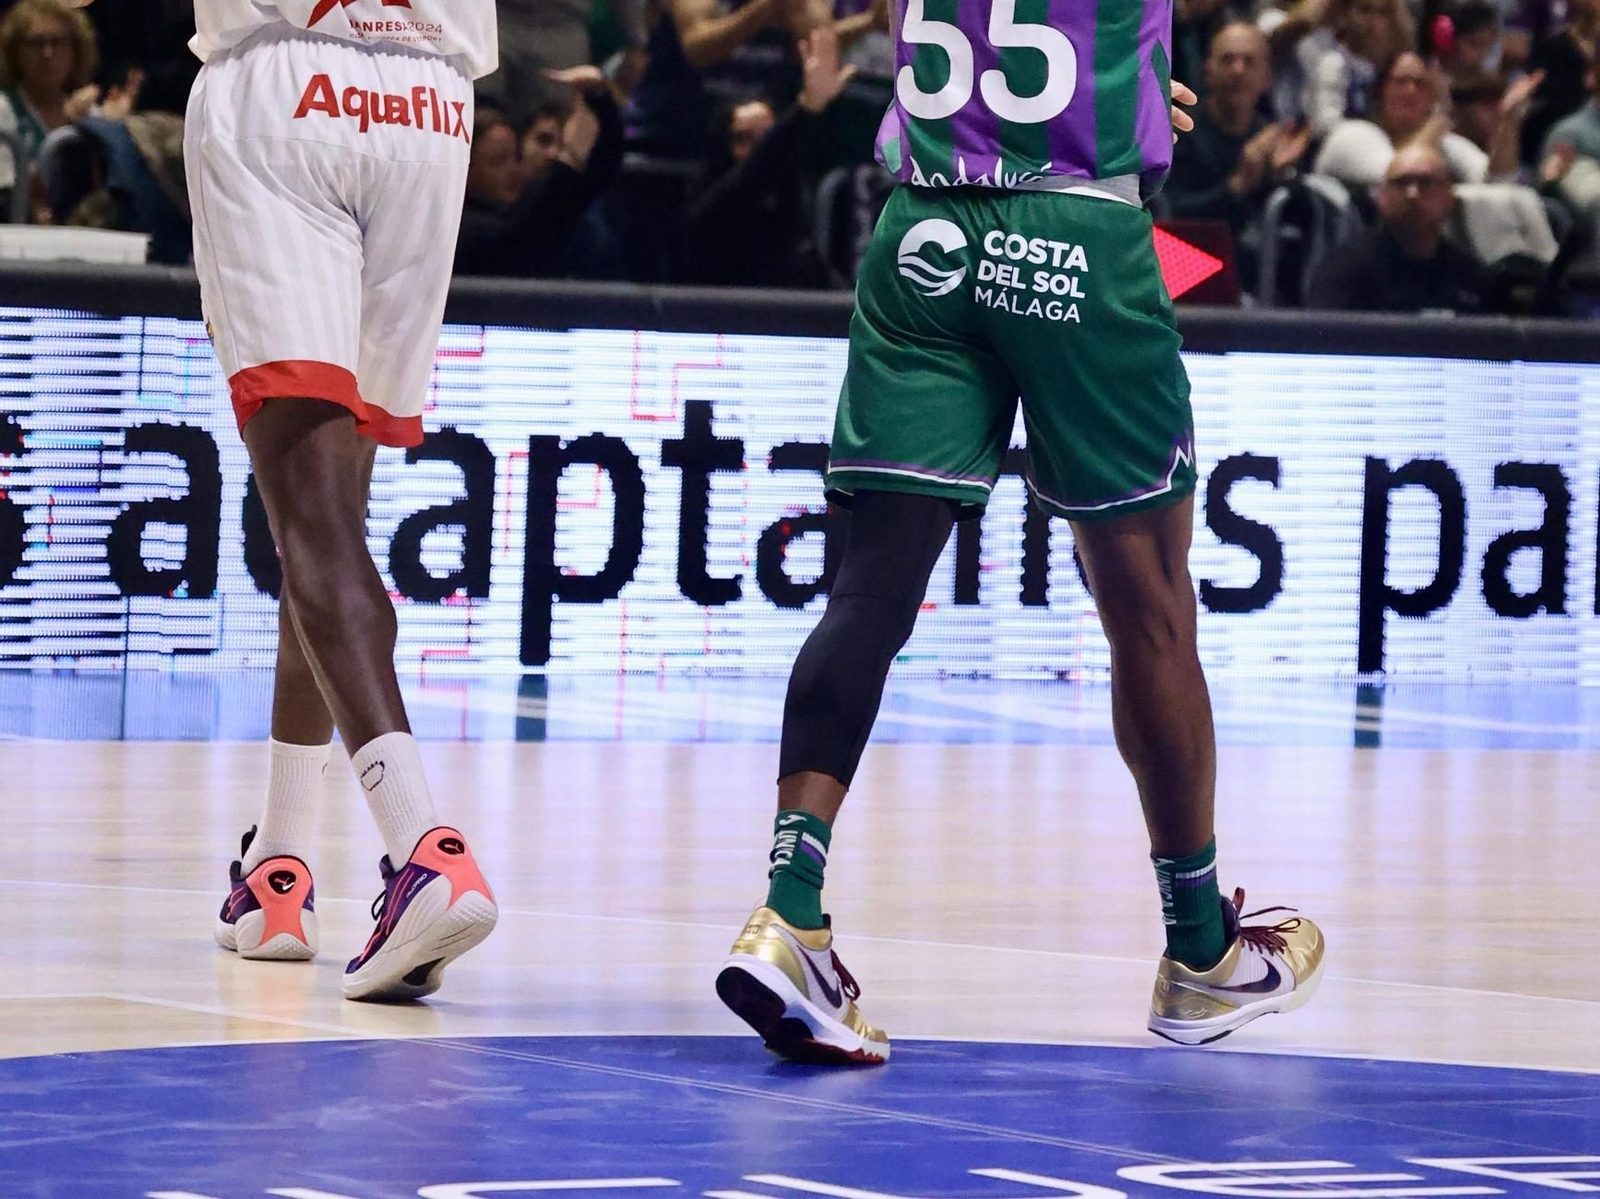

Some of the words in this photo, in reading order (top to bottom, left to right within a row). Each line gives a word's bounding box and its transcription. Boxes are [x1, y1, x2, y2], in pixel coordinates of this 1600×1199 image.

[293, 73, 471, 145] Aquaflix
[983, 230, 1090, 273] COSTA
[977, 259, 1027, 290] DEL
[1031, 270, 1086, 299] SOL
[974, 286, 1081, 324] MÁLAGA
[1356, 455, 1600, 673] pa
